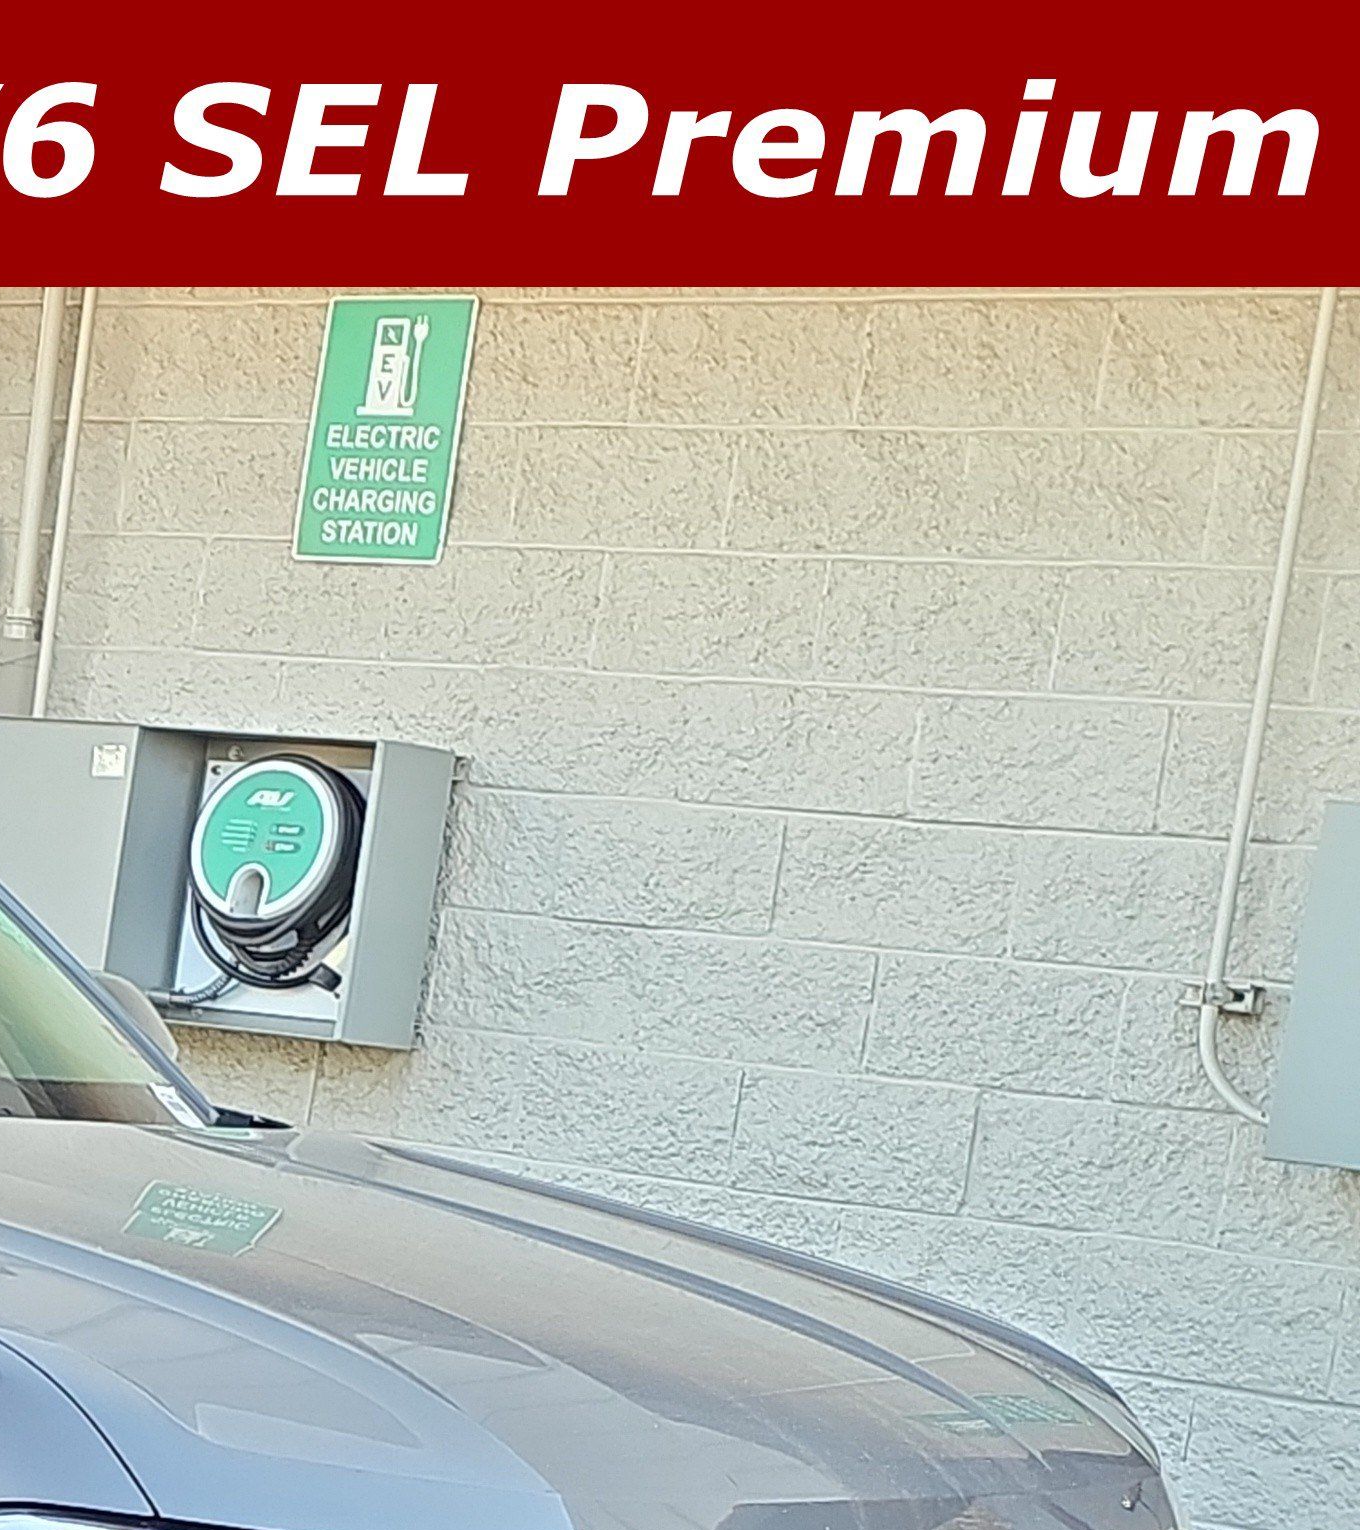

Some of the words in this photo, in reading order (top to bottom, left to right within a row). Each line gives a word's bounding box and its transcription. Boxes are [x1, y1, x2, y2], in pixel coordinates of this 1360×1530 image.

[326, 424, 440, 450] ELECTRIC
[330, 457, 429, 483] VEHICLE
[312, 487, 437, 515] CHARGING
[321, 519, 418, 545] STATION
